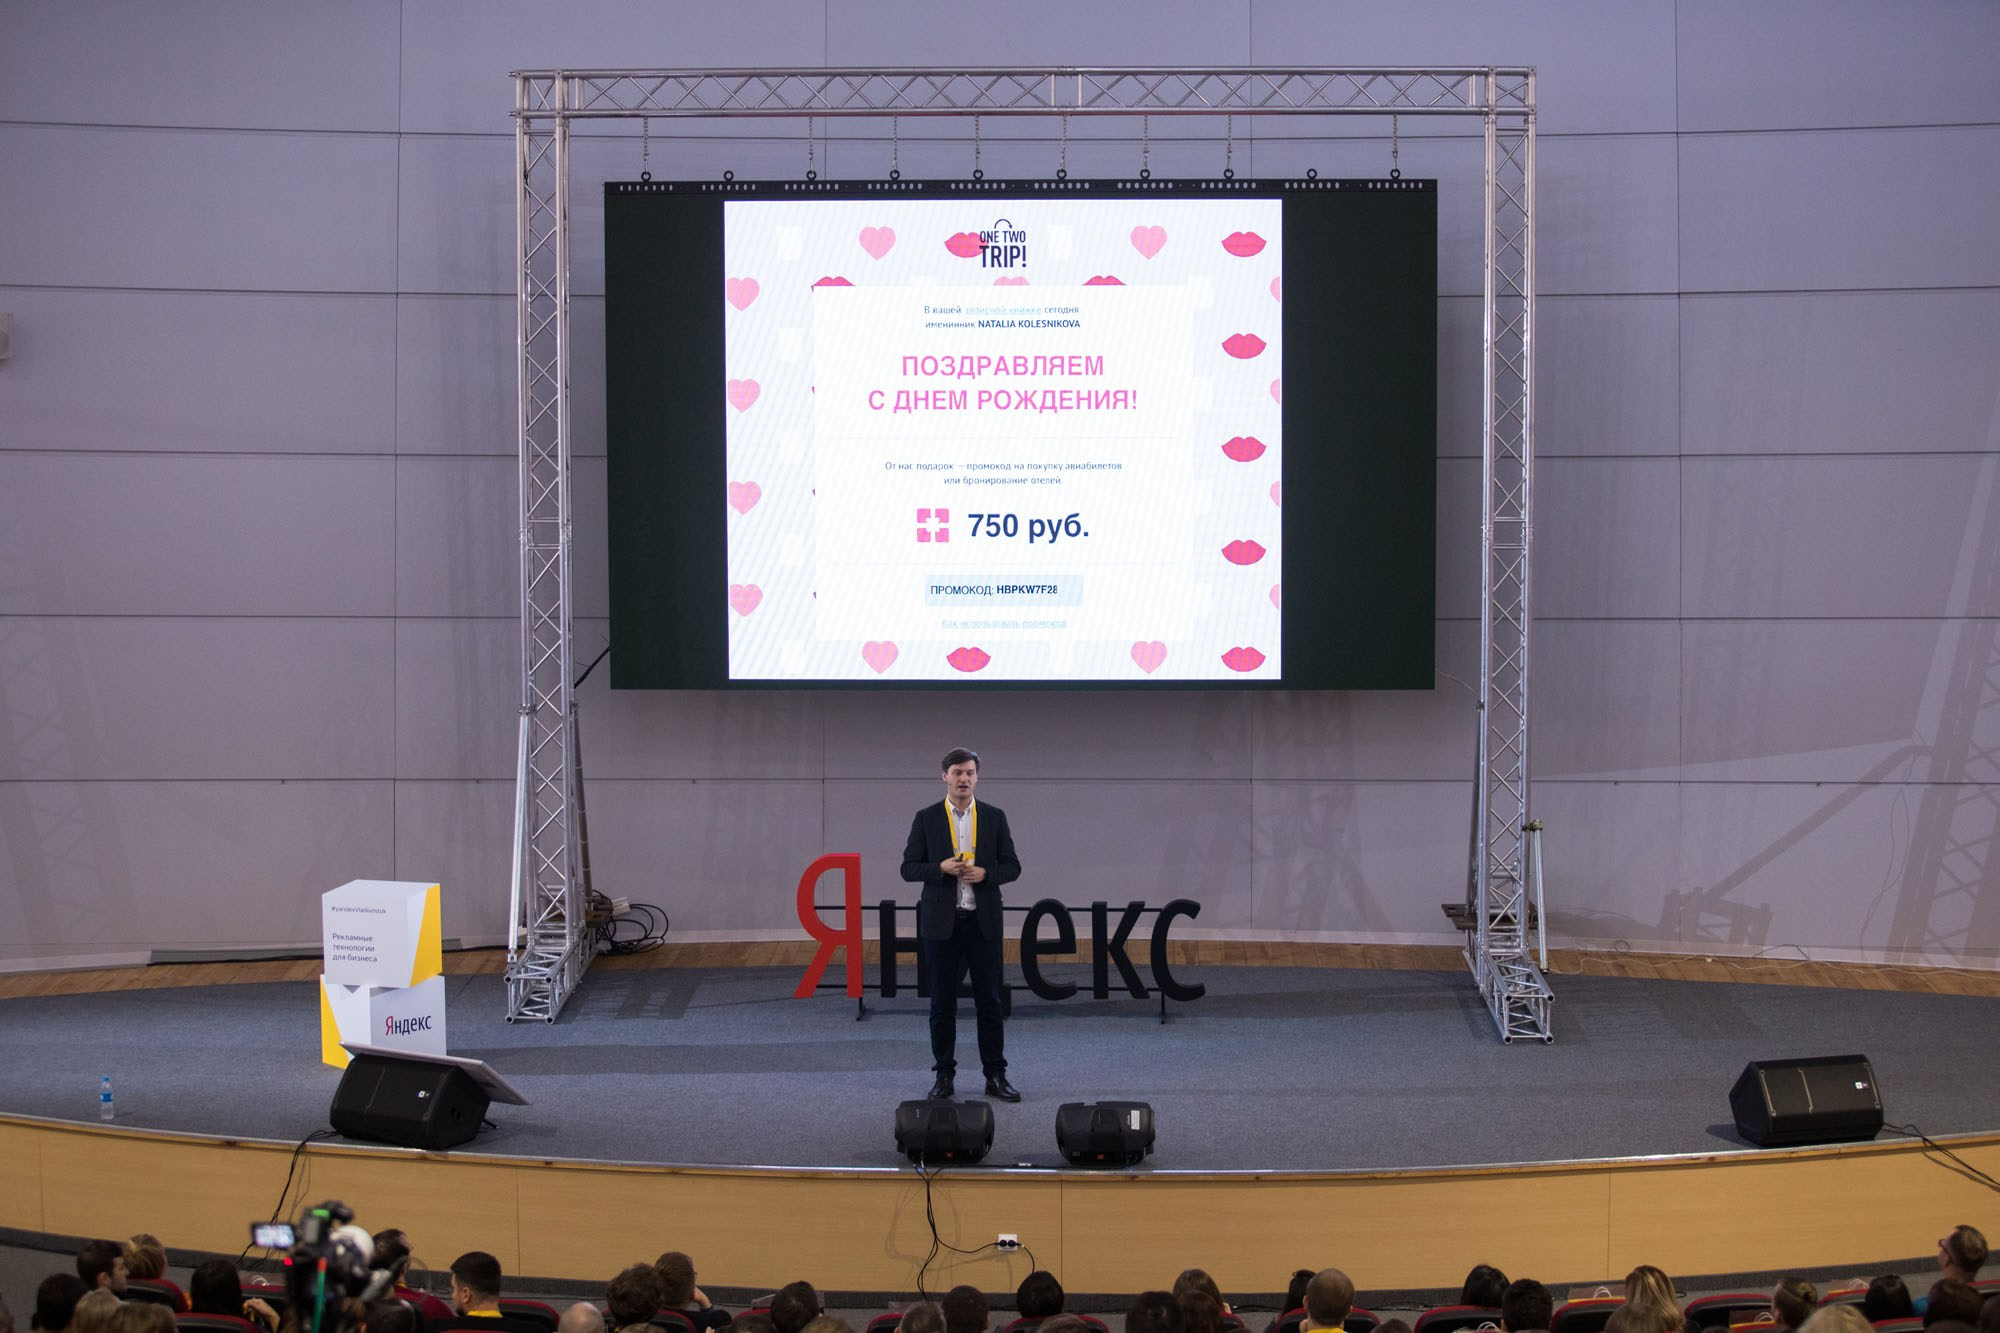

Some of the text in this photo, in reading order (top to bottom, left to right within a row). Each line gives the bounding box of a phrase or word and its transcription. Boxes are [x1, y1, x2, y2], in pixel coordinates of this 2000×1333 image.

[979, 231, 1026, 243] ONE TWO
[979, 245, 1027, 268] TRIP!
[924, 306, 930, 314] В
[933, 305, 962, 314] вашей
[1044, 306, 1079, 315] сегодня
[978, 320, 1016, 328] NATALIA
[1018, 320, 1080, 328] KOLESNIKOVA
[902, 355, 1104, 379] ПОЗДРАВЛЯЕМ
[868, 389, 1138, 414] С ДНЕМ РОЖДЕНИЯ!
[885, 461, 896, 470] От
[916, 463, 954, 472] подарок
[966, 463, 1011, 472] промокод
[1027, 463, 1063, 472] покупку
[1065, 461, 1122, 470] авиабилетов
[944, 475, 1063, 486] или бронирование отелей.
[967, 512, 1089, 544] 750 руб.
[930, 585, 1058, 596] ПРОМОКОД: HBPKW7F28
[332, 932, 374, 942] Рекламные
[793, 852, 1206, 1018] Янекс
[332, 944, 375, 952] технологии
[347, 953, 378, 963] бизнеса
[385, 1015, 432, 1036] Яндекс
